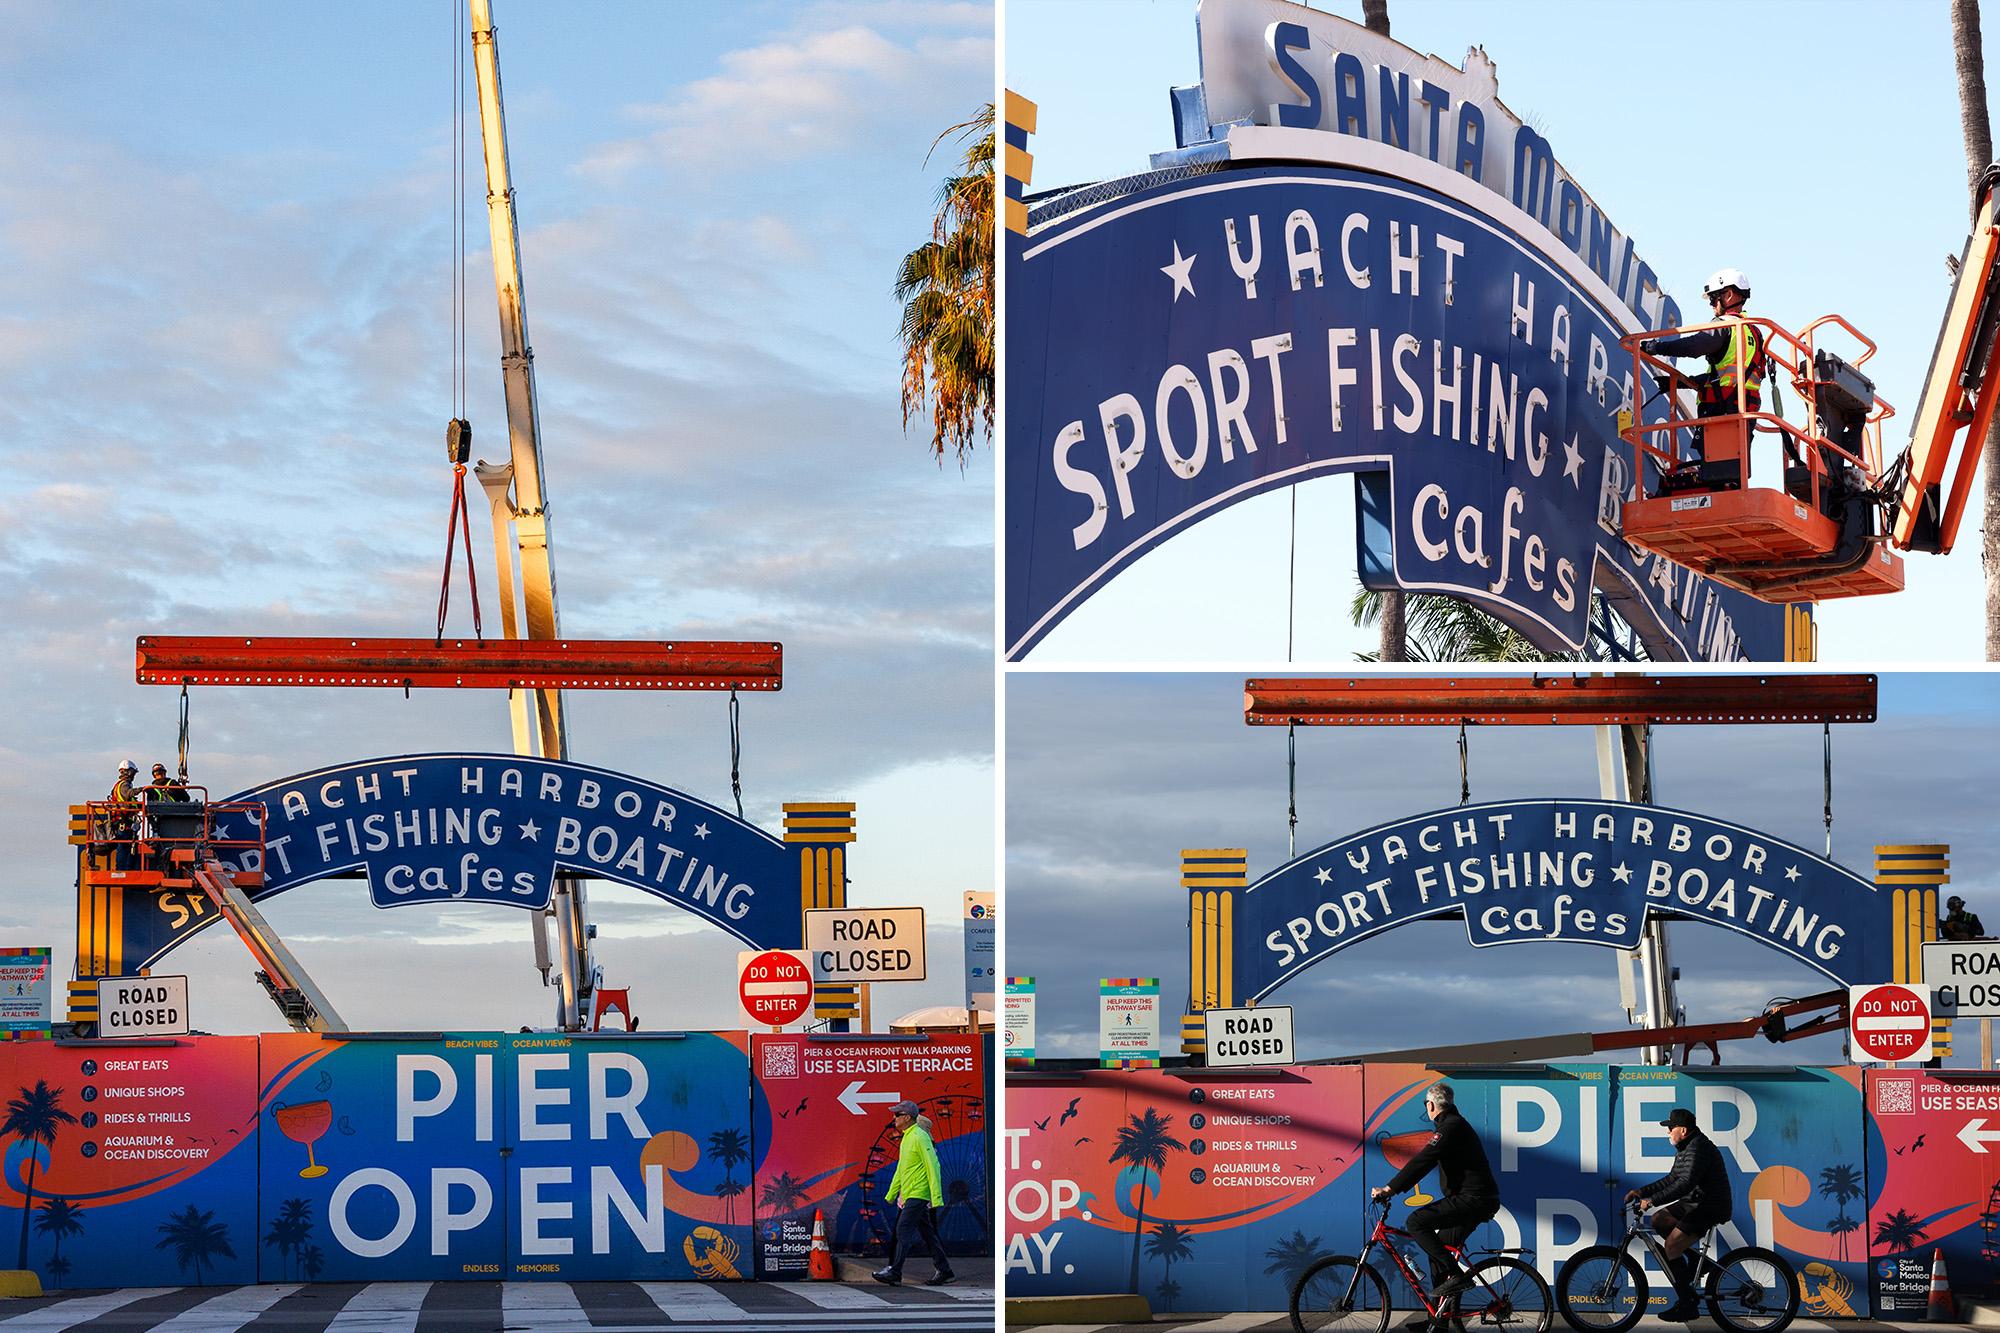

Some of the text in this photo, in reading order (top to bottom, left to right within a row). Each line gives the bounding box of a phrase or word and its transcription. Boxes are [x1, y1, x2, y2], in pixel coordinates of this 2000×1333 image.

[1266, 20, 1485, 184] SANTA
[1224, 208, 1465, 305] YACHT
[1053, 332, 1293, 550] SPORT
[1329, 327, 1548, 478] FISHING
[461, 767, 677, 833] HARBOR
[1345, 811, 1767, 875] YACHT HARBOR
[315, 807, 503, 863] FISHING
[555, 816, 756, 920] BOATING
[1265, 851, 1846, 967] SPORT FISHING BOATING
[832, 918, 896, 942] ROAD
[820, 949, 912, 973] CLOSED
[750, 965, 801, 979] DO NOT
[119, 987, 168, 1005] ROAD
[756, 999, 797, 1012] ENTER
[1863, 1000, 1918, 1013] DO NOT
[110, 1008, 178, 1027] CLOSED
[1225, 1017, 1273, 1034] ROAD
[446, 1039, 572, 1048] BEACH VIBES OCEAN VIEWS
[1869, 1034, 1913, 1046] ENTER
[804, 1048, 823, 1057] PIER
[825, 1047, 833, 1057] &
[903, 1046, 929, 1055] WALK
[931, 1045, 971, 1055] PARKING
[1217, 1038, 1284, 1057] CLOSED
[104, 1060, 169, 1071] GREAT EATS
[804, 1057, 973, 1074] USE SEASIDE TERRACE
[1580, 1072, 1604, 1080] VIBES
[1619, 1072, 1648, 1080] OCEAN
[1651, 1072, 1678, 1080] VIEWS
[104, 1087, 185, 1098] UNIQUE SHOPS
[1212, 1089, 1275, 1099] GREAT EATS
[1920, 1084, 1941, 1093] PIER
[1943, 1084, 1951, 1093] &
[1953, 1084, 1990, 1093] OCEAN
[396, 1052, 653, 1142] PIER
[1922, 1096, 1952, 1110] USE
[104, 1112, 191, 1124] RIDES & THRILLS
[1212, 1115, 1291, 1126] UNIQUE SHOPS
[1500, 1085, 1762, 1173] PIER
[104, 1136, 174, 1147] AQUARIUM &
[1212, 1140, 1297, 1151] RIDES & THRILLS
[104, 1148, 210, 1160] OCEAN DISCOVERY
[1213, 1163, 1280, 1174] AQUARIUM &
[1213, 1175, 1316, 1187] OCEAN DISCOVERY
[1008, 1179, 1092, 1222] OP.
[328, 1164, 665, 1258] OPEN
[764, 1243, 811, 1254] Pier Bridge
[1005, 1232, 1075, 1275] AY.
[463, 1264, 560, 1273] ENDLESS MEMORIES
[1899, 1271, 1930, 1280] Monica
[1880, 1282, 1930, 1294] Pier Bridge
[1623, 1296, 1668, 1304] MERIES
